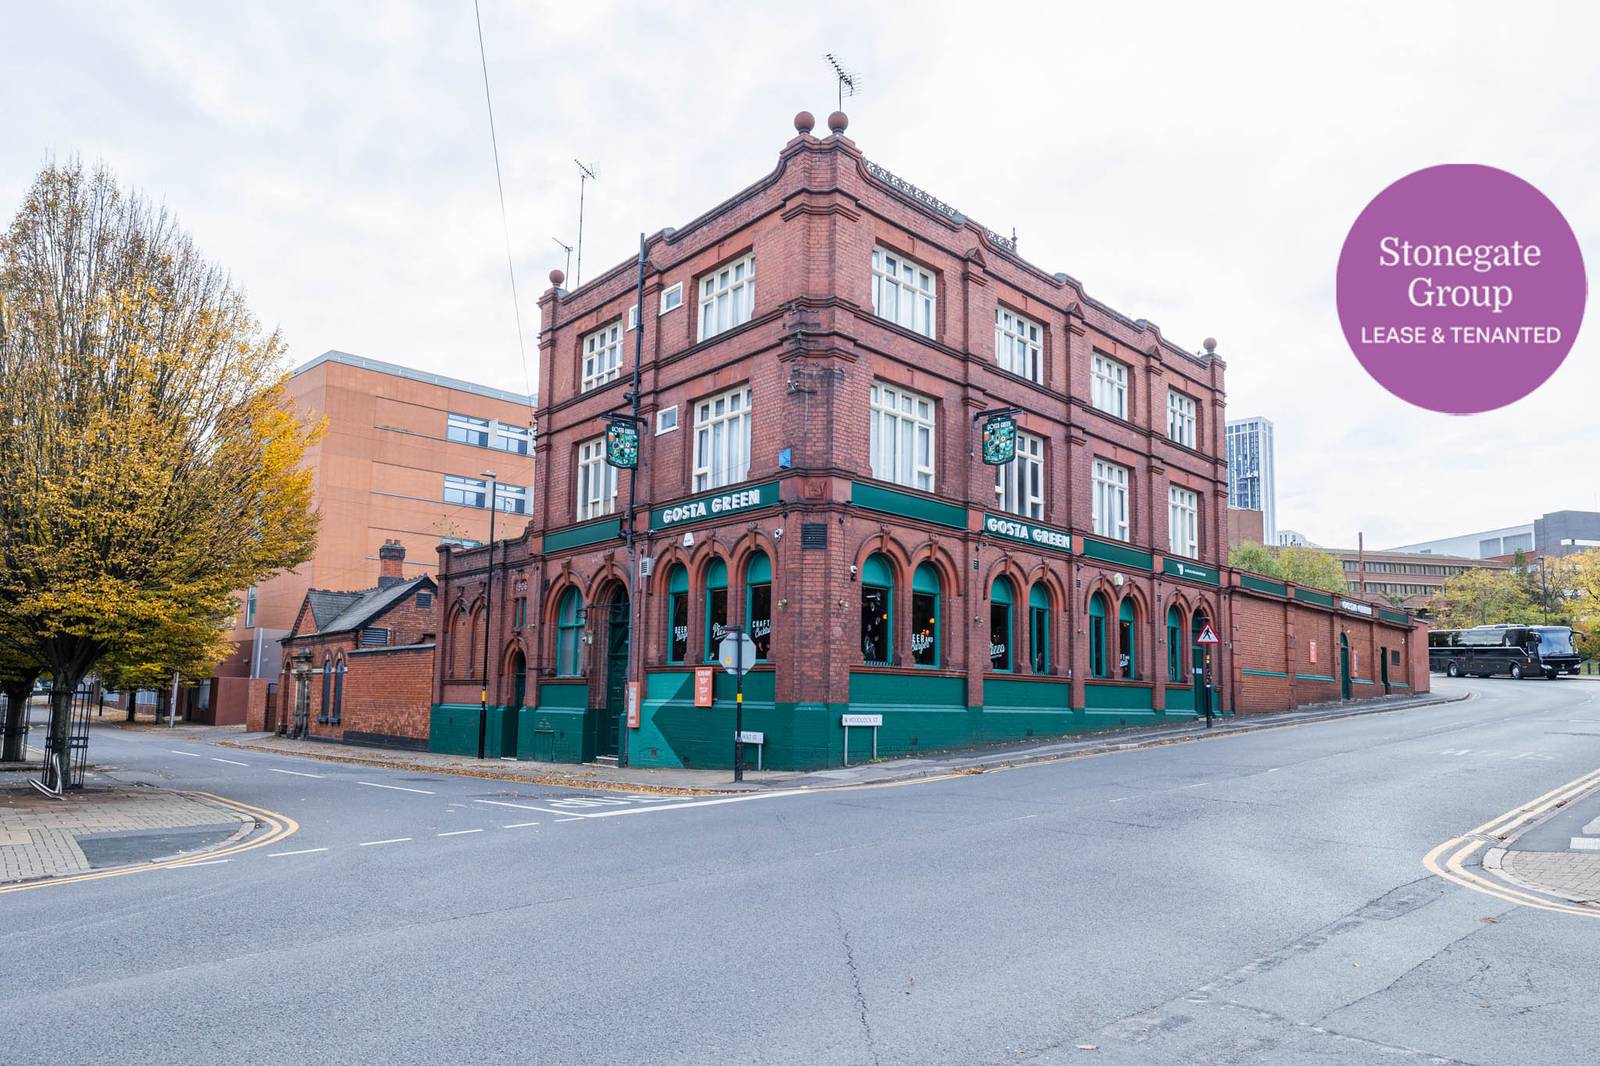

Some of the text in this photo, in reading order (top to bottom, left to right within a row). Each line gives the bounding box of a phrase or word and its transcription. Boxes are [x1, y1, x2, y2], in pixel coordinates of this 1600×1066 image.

[663, 489, 760, 524] GOSTA GREEN
[987, 518, 1071, 549] GOSTA GREEN
[911, 633, 925, 643] EER
